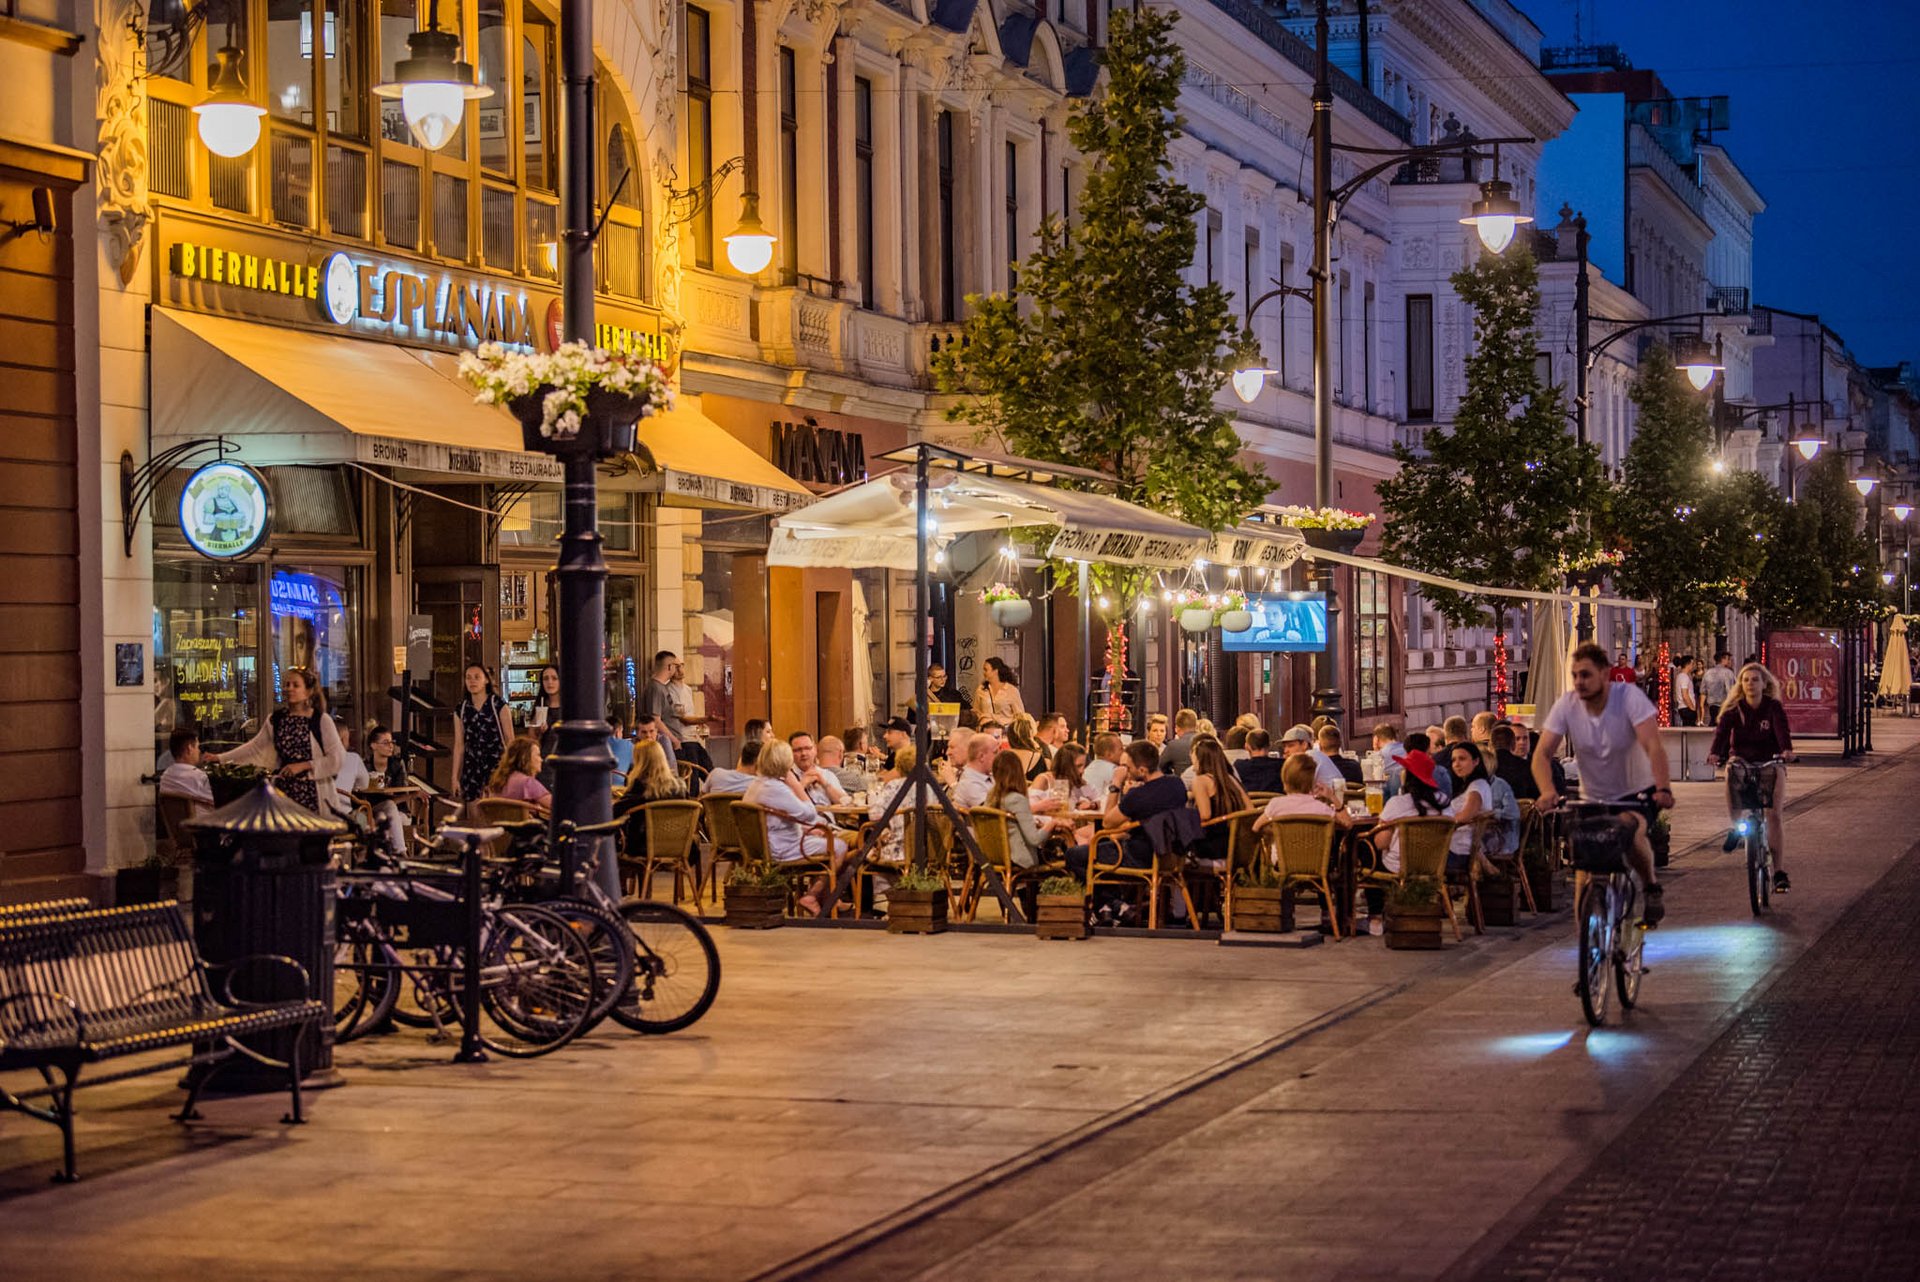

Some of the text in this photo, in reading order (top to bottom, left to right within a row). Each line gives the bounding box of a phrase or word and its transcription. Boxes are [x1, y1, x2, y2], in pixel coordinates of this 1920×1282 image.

[181, 242, 318, 300] BIERHALLE
[356, 264, 539, 353] ESPLANADA
[595, 323, 667, 361] IERHLLE
[373, 443, 408, 463] BROWAR
[509, 461, 562, 478] RESTAURACJA
[1055, 529, 1100, 552] BROWAR
